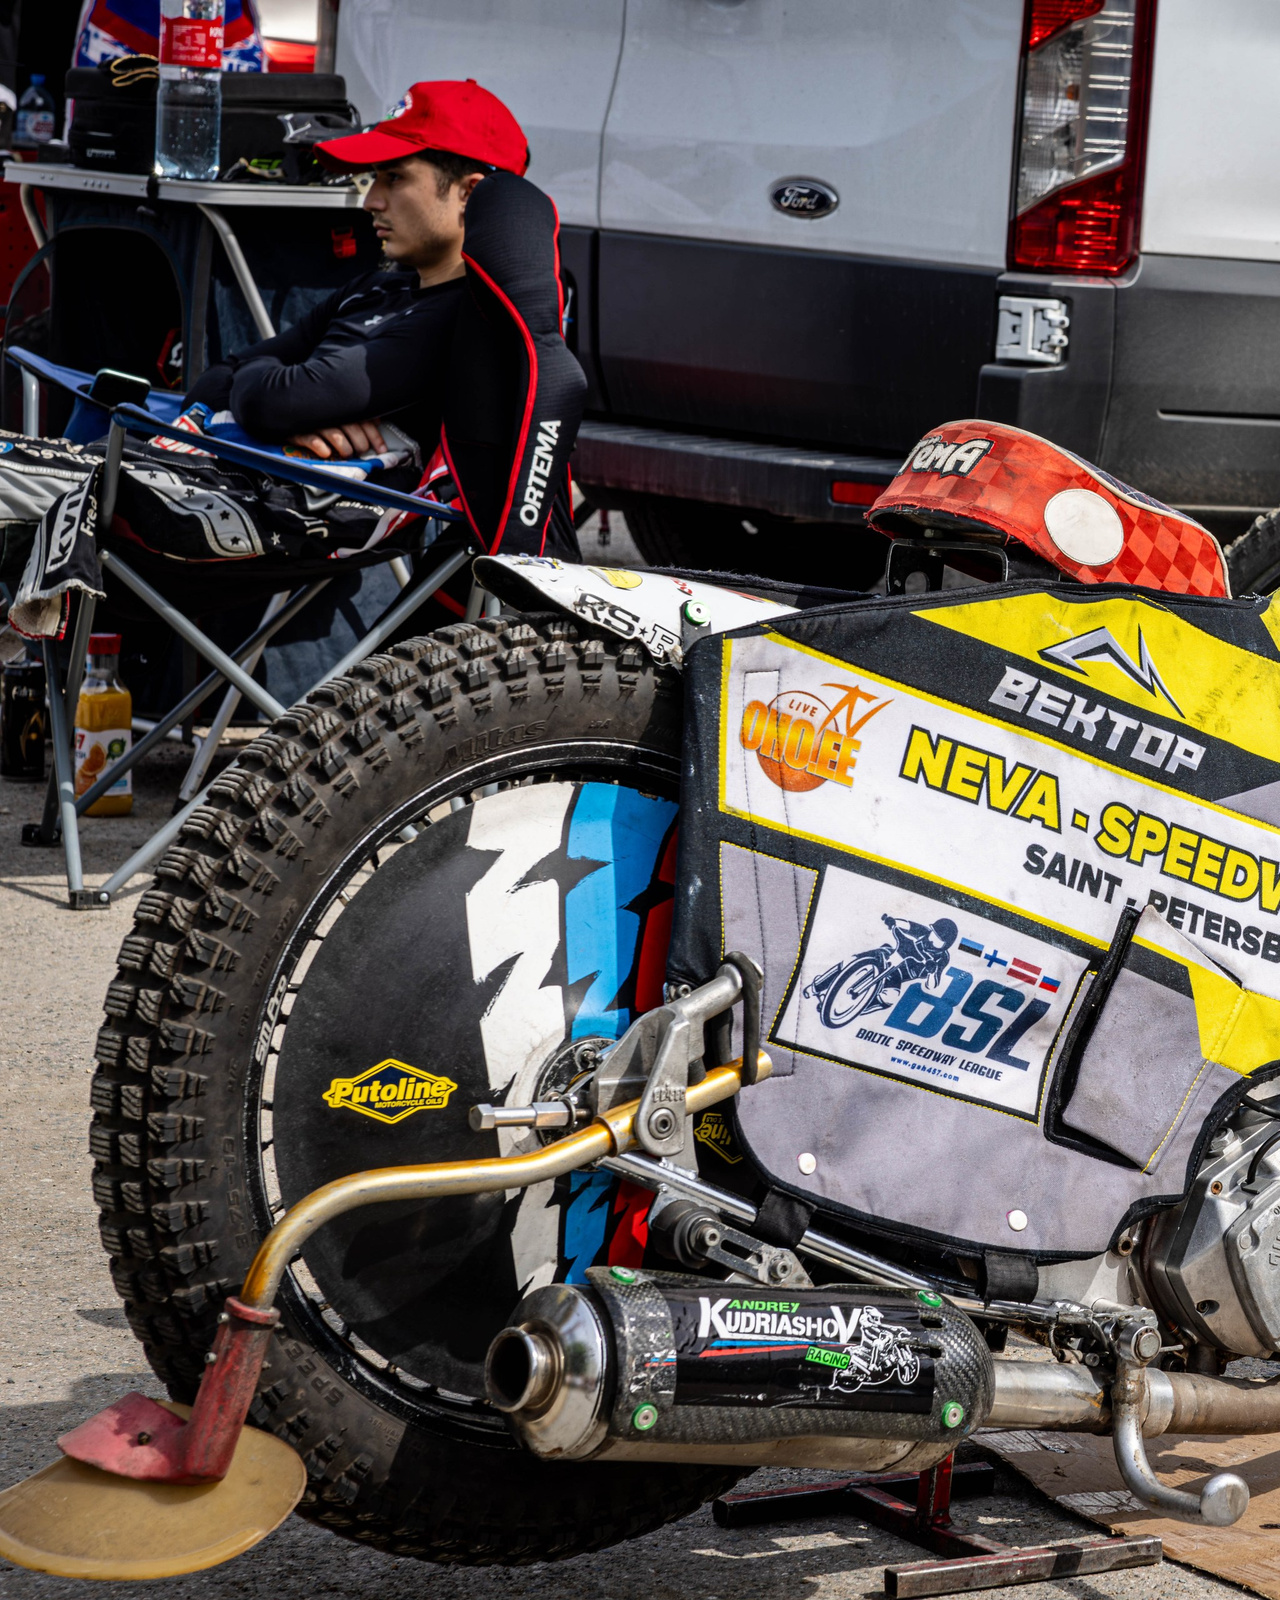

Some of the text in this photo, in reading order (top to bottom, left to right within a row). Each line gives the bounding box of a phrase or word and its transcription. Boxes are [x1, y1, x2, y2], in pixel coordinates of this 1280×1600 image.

[780, 186, 819, 209] Ford
[520, 420, 562, 526] ORTEMA
[788, 699, 818, 717] LIVE
[435, 719, 547, 776] Mitas
[899, 723, 1061, 834] NEVA
[1023, 843, 1122, 905] SAINT
[884, 967, 1051, 1072] BSL
[856, 1028, 1003, 1082] BALTIC SPEEDWAY LEAGUE
[333, 1077, 447, 1106] Putoline
[374, 1097, 443, 1109] MOTORCYCLE OILS
[728, 1299, 800, 1313] ANDREY
[806, 1348, 850, 1368] RACING
